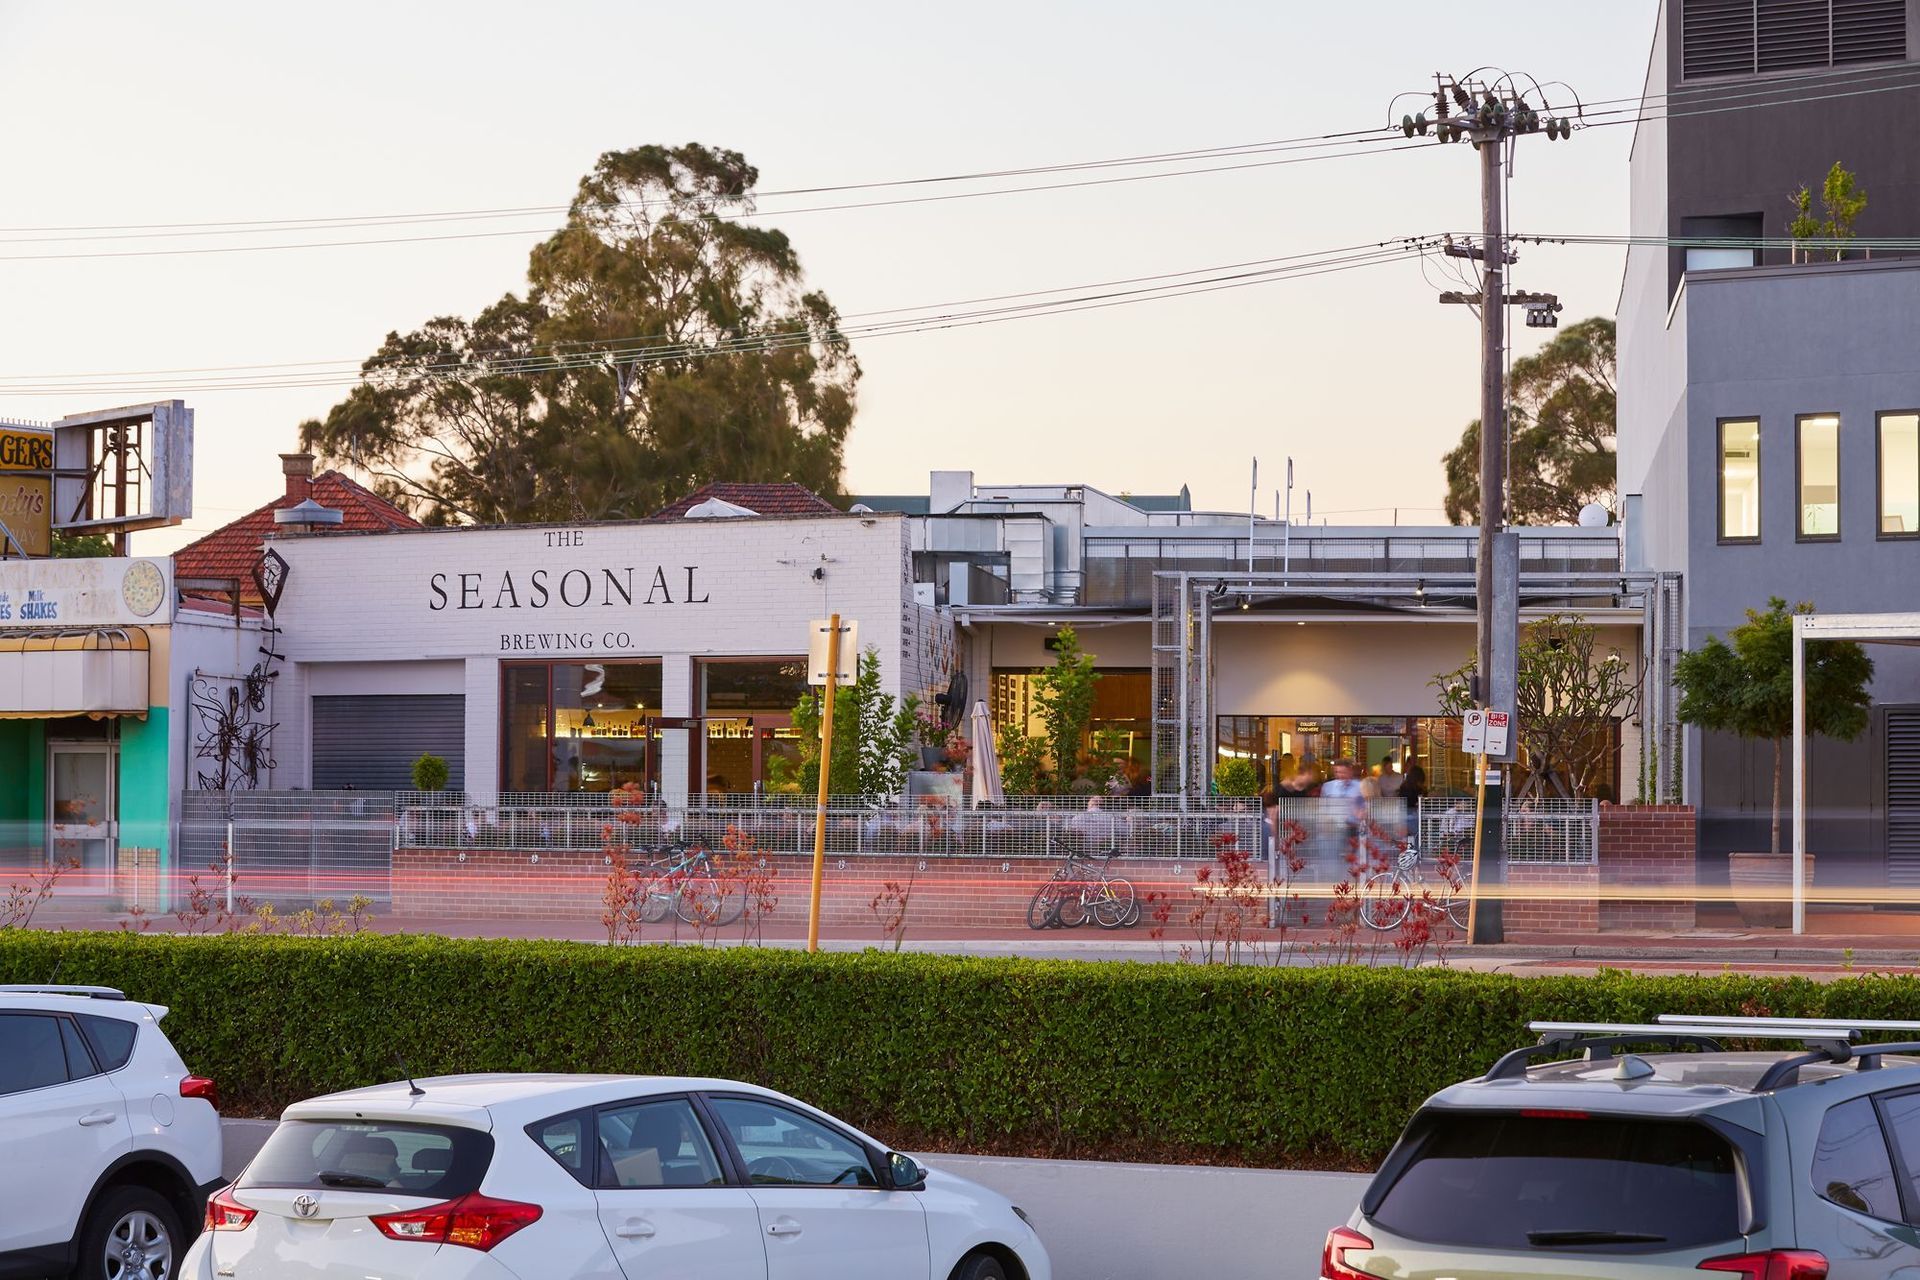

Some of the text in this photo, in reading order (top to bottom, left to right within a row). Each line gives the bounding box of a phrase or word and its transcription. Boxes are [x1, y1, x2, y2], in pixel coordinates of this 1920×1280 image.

[544, 530, 584, 547] THE
[28, 590, 44, 602] Milk
[429, 565, 711, 611] SEASONAL
[20, 602, 57, 620] SHAKES
[501, 632, 635, 650] BREWING CO.
[1488, 719, 1506, 727] ZONE
